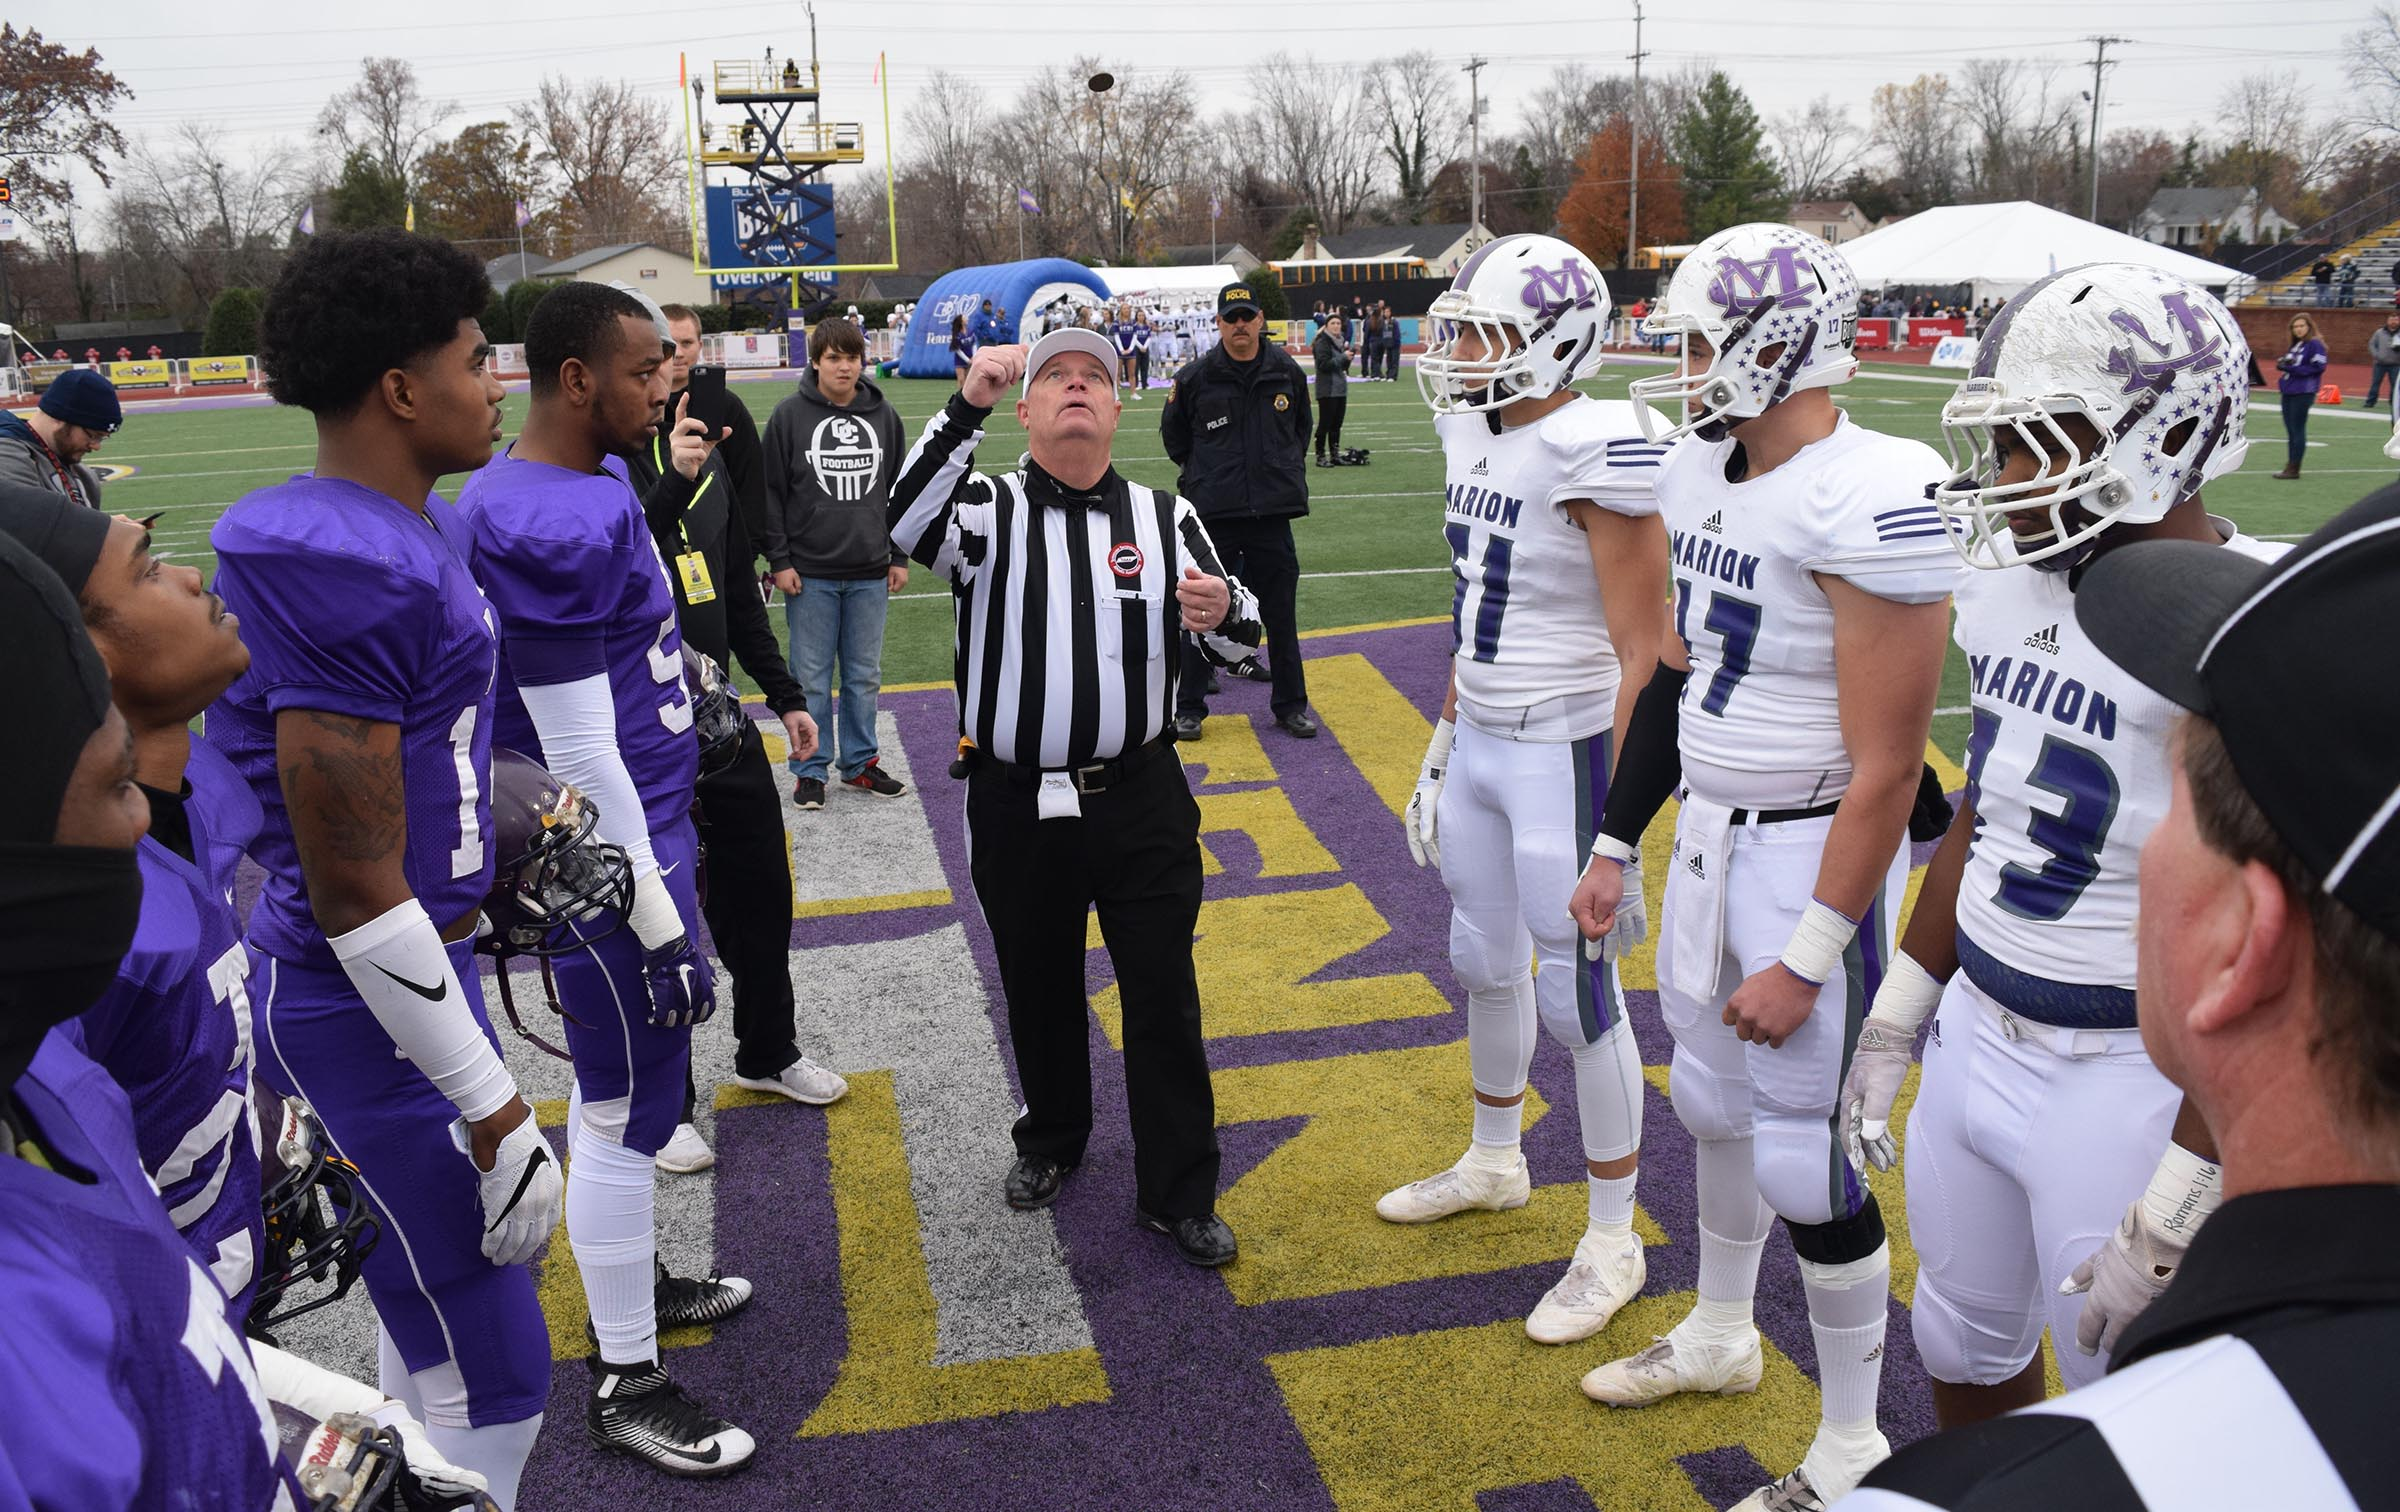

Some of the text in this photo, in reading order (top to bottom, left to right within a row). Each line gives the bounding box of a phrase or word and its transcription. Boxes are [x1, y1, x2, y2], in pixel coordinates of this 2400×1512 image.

[1828, 318, 1839, 333] 17
[1918, 327, 1952, 337] Wilson
[1206, 416, 1229, 431] POLICE
[822, 456, 872, 470] FOOTBALL
[1701, 521, 1723, 535] adidas
[1672, 529, 1761, 591] MARION
[2023, 636, 2061, 656] adidas
[1970, 654, 2117, 742] MARION
[2163, 1166, 2217, 1234] Romans 1:16
